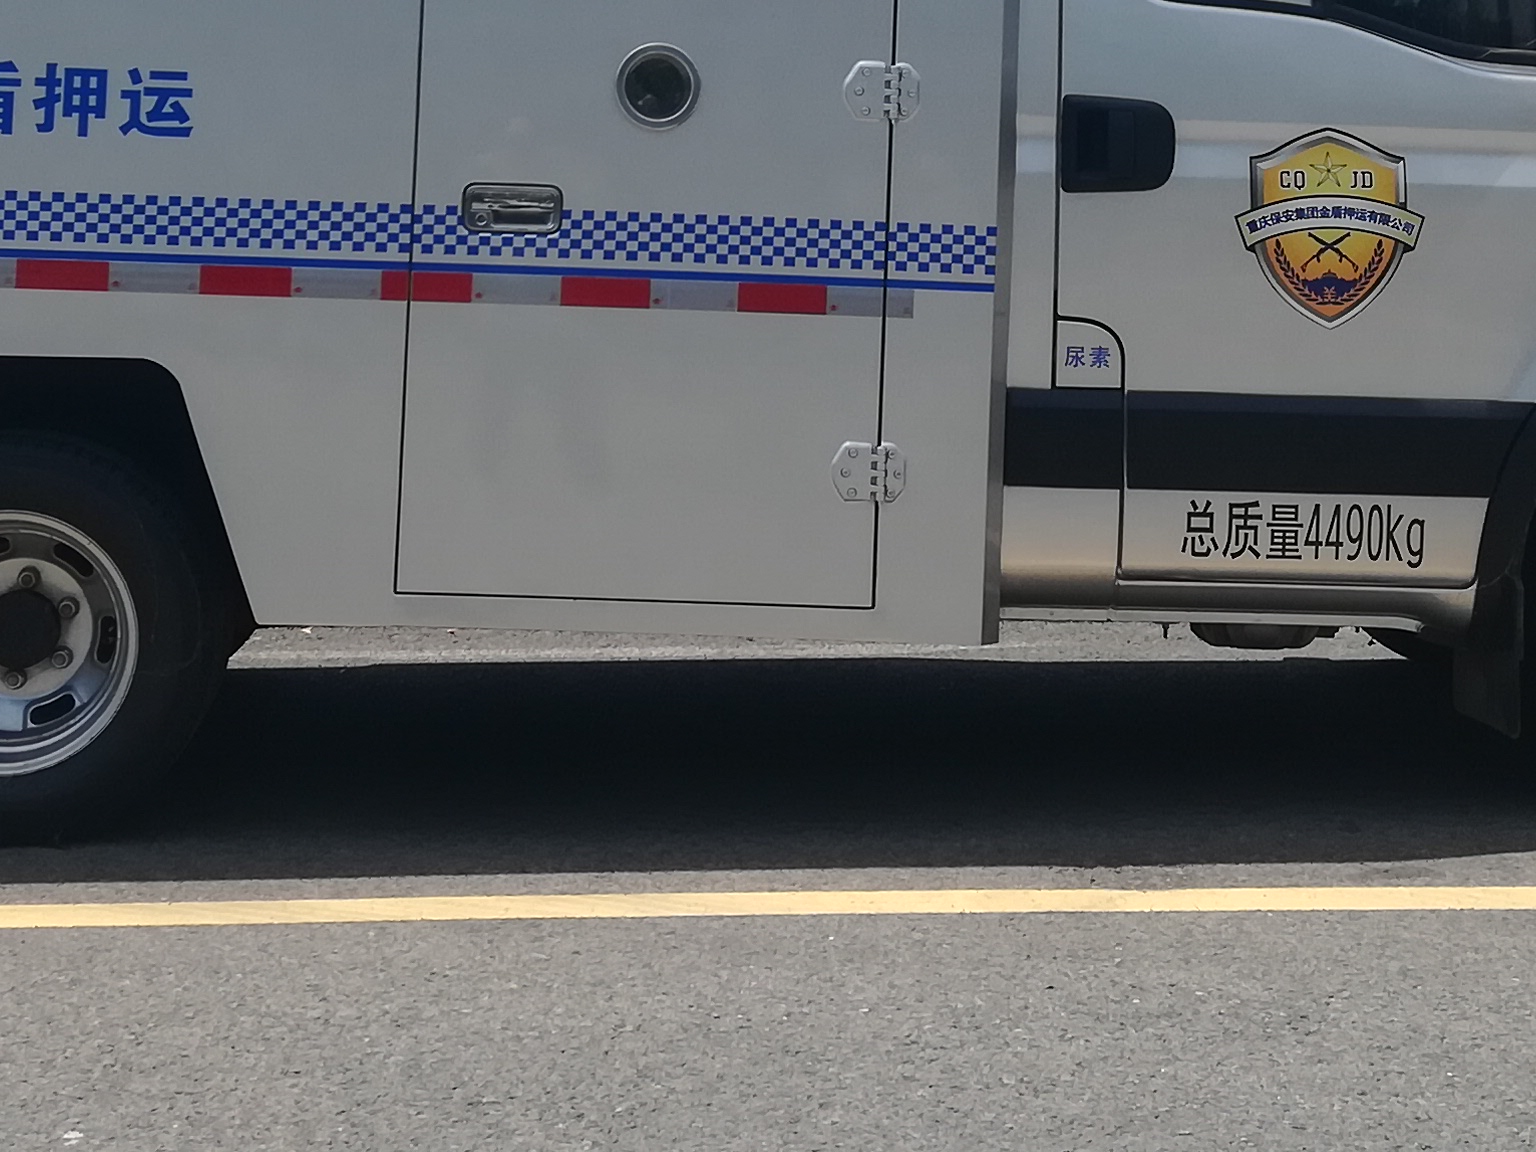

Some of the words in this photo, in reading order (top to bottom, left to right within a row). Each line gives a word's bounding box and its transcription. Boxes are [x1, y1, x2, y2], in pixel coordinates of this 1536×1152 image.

[1279, 170, 1306, 190] CQ
[1350, 170, 1374, 189] JD
[1245, 205, 1416, 236] 重庆保安集团金盾押运有限公司
[1064, 345, 1111, 368] 尿素
